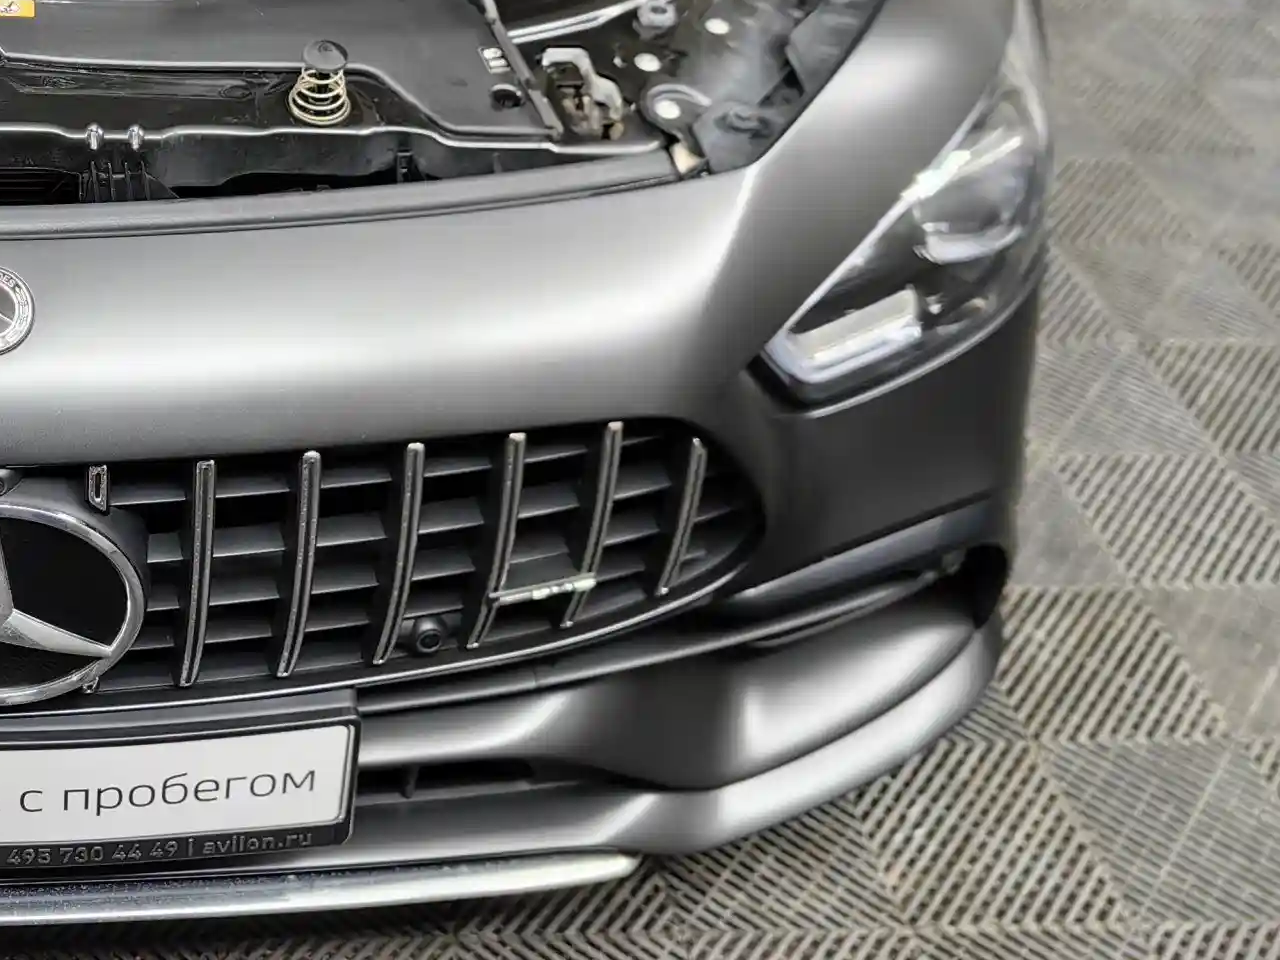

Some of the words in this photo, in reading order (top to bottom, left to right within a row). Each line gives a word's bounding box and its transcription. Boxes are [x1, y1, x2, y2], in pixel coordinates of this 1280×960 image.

[19, 790, 43, 813] с
[63, 770, 316, 817] пробегом
[6, 848, 52, 865] 495
[59, 846, 104, 864] 730
[111, 843, 143, 861] 44
[149, 841, 178, 858] 49
[202, 833, 313, 854] avilon.ru
